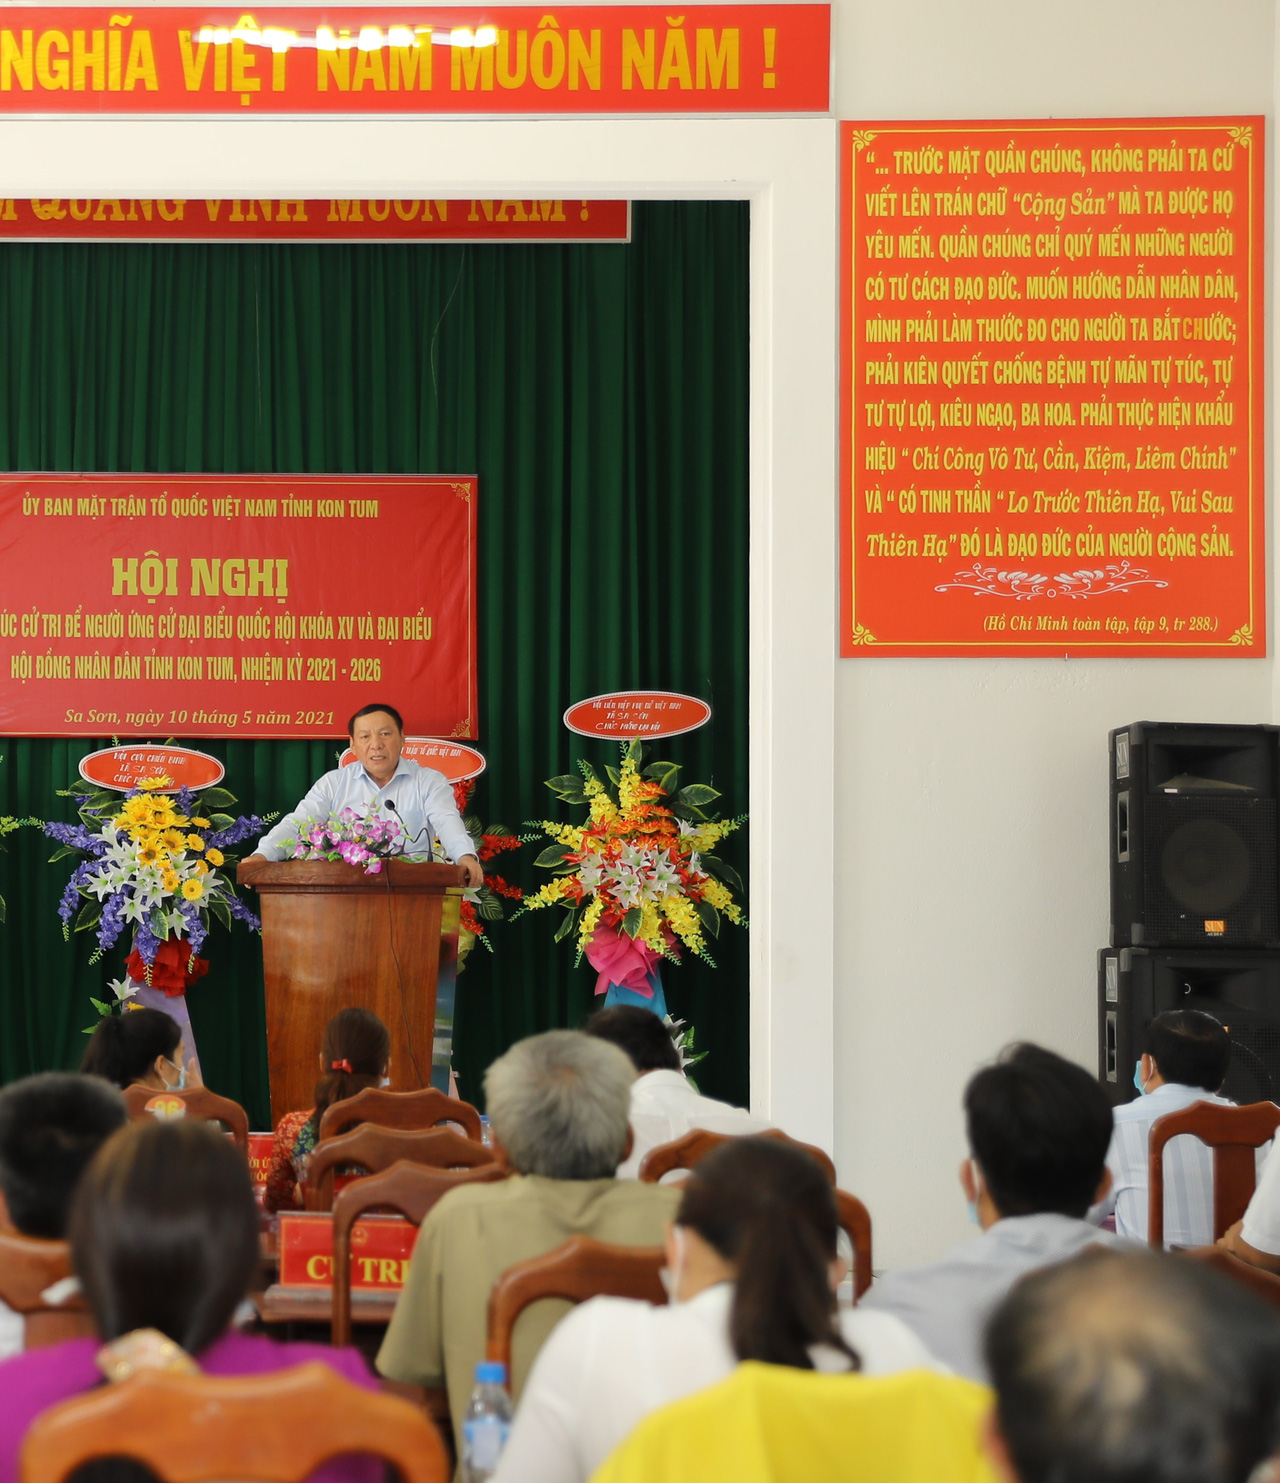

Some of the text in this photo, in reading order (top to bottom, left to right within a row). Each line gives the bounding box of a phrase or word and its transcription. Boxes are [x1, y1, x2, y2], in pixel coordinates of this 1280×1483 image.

[0, 14, 159, 91] NGHĨA
[178, 13, 298, 105] VIỆT
[317, 25, 434, 91] NAM
[451, 15, 602, 90] MUÔN
[622, 16, 740, 90] NĂM
[894, 145, 945, 174] TRƯỚC
[948, 146, 981, 179] MẶT
[985, 140, 1027, 176] QUẦN
[1030, 144, 1087, 176] CHÚNG,
[1091, 143, 1144, 172] KHÔNG
[1148, 140, 1184, 171] PHẢI
[1188, 148, 1209, 171] TA
[1212, 140, 1236, 172] CỨ
[865, 185, 1235, 221] VIẾT LÊN TRÁN CHỮ “Cộng Sản” MÀ TA ĐƯỢC HỌ
[22, 492, 379, 520] ỦY BAN MẶT TRẬN TỔ QUỐC VIỆT NAM TỈNH KON TUM
[112, 550, 289, 603] HỘI NGHỊ
[21, 607, 41, 637] CỬ
[41, 614, 62, 637] TRI
[65, 605, 82, 637] ĐỂ
[85, 610, 125, 638] NGƯỜI
[128, 610, 155, 638] ỨNG
[158, 607, 177, 638] CỬ
[179, 615, 201, 643] ĐẠI
[204, 606, 234, 638] BIỂU
[237, 607, 272, 640] QUỐC
[275, 611, 297, 644] HỘI
[300, 611, 334, 639] KHÓA
[337, 616, 354, 639] XV
[358, 612, 375, 639] VÀ
[377, 616, 400, 644] ĐẠI
[402, 608, 433, 640] BIỂU
[984, 614, 1219, 634] (Hồ Chí Minh toàn tập, tập 9, tr 288.)
[11, 651, 33, 683] HỘI
[35, 649, 71, 678] ĐỒNG
[75, 651, 111, 679] NHÂN
[114, 651, 141, 679] DÂN
[144, 650, 174, 679] TỈNH
[177, 656, 203, 679] KON
[206, 656, 238, 683] TUM,
[241, 653, 284, 685] NHIỆM
[287, 652, 304, 680] KỲ
[307, 658, 336, 681] 2021
[350, 658, 382, 681] 2026
[65, 709, 335, 727] Sa Sơn, ngày 10 tháng 5 năm 2021
[1205, 921, 1223, 932] SUN
